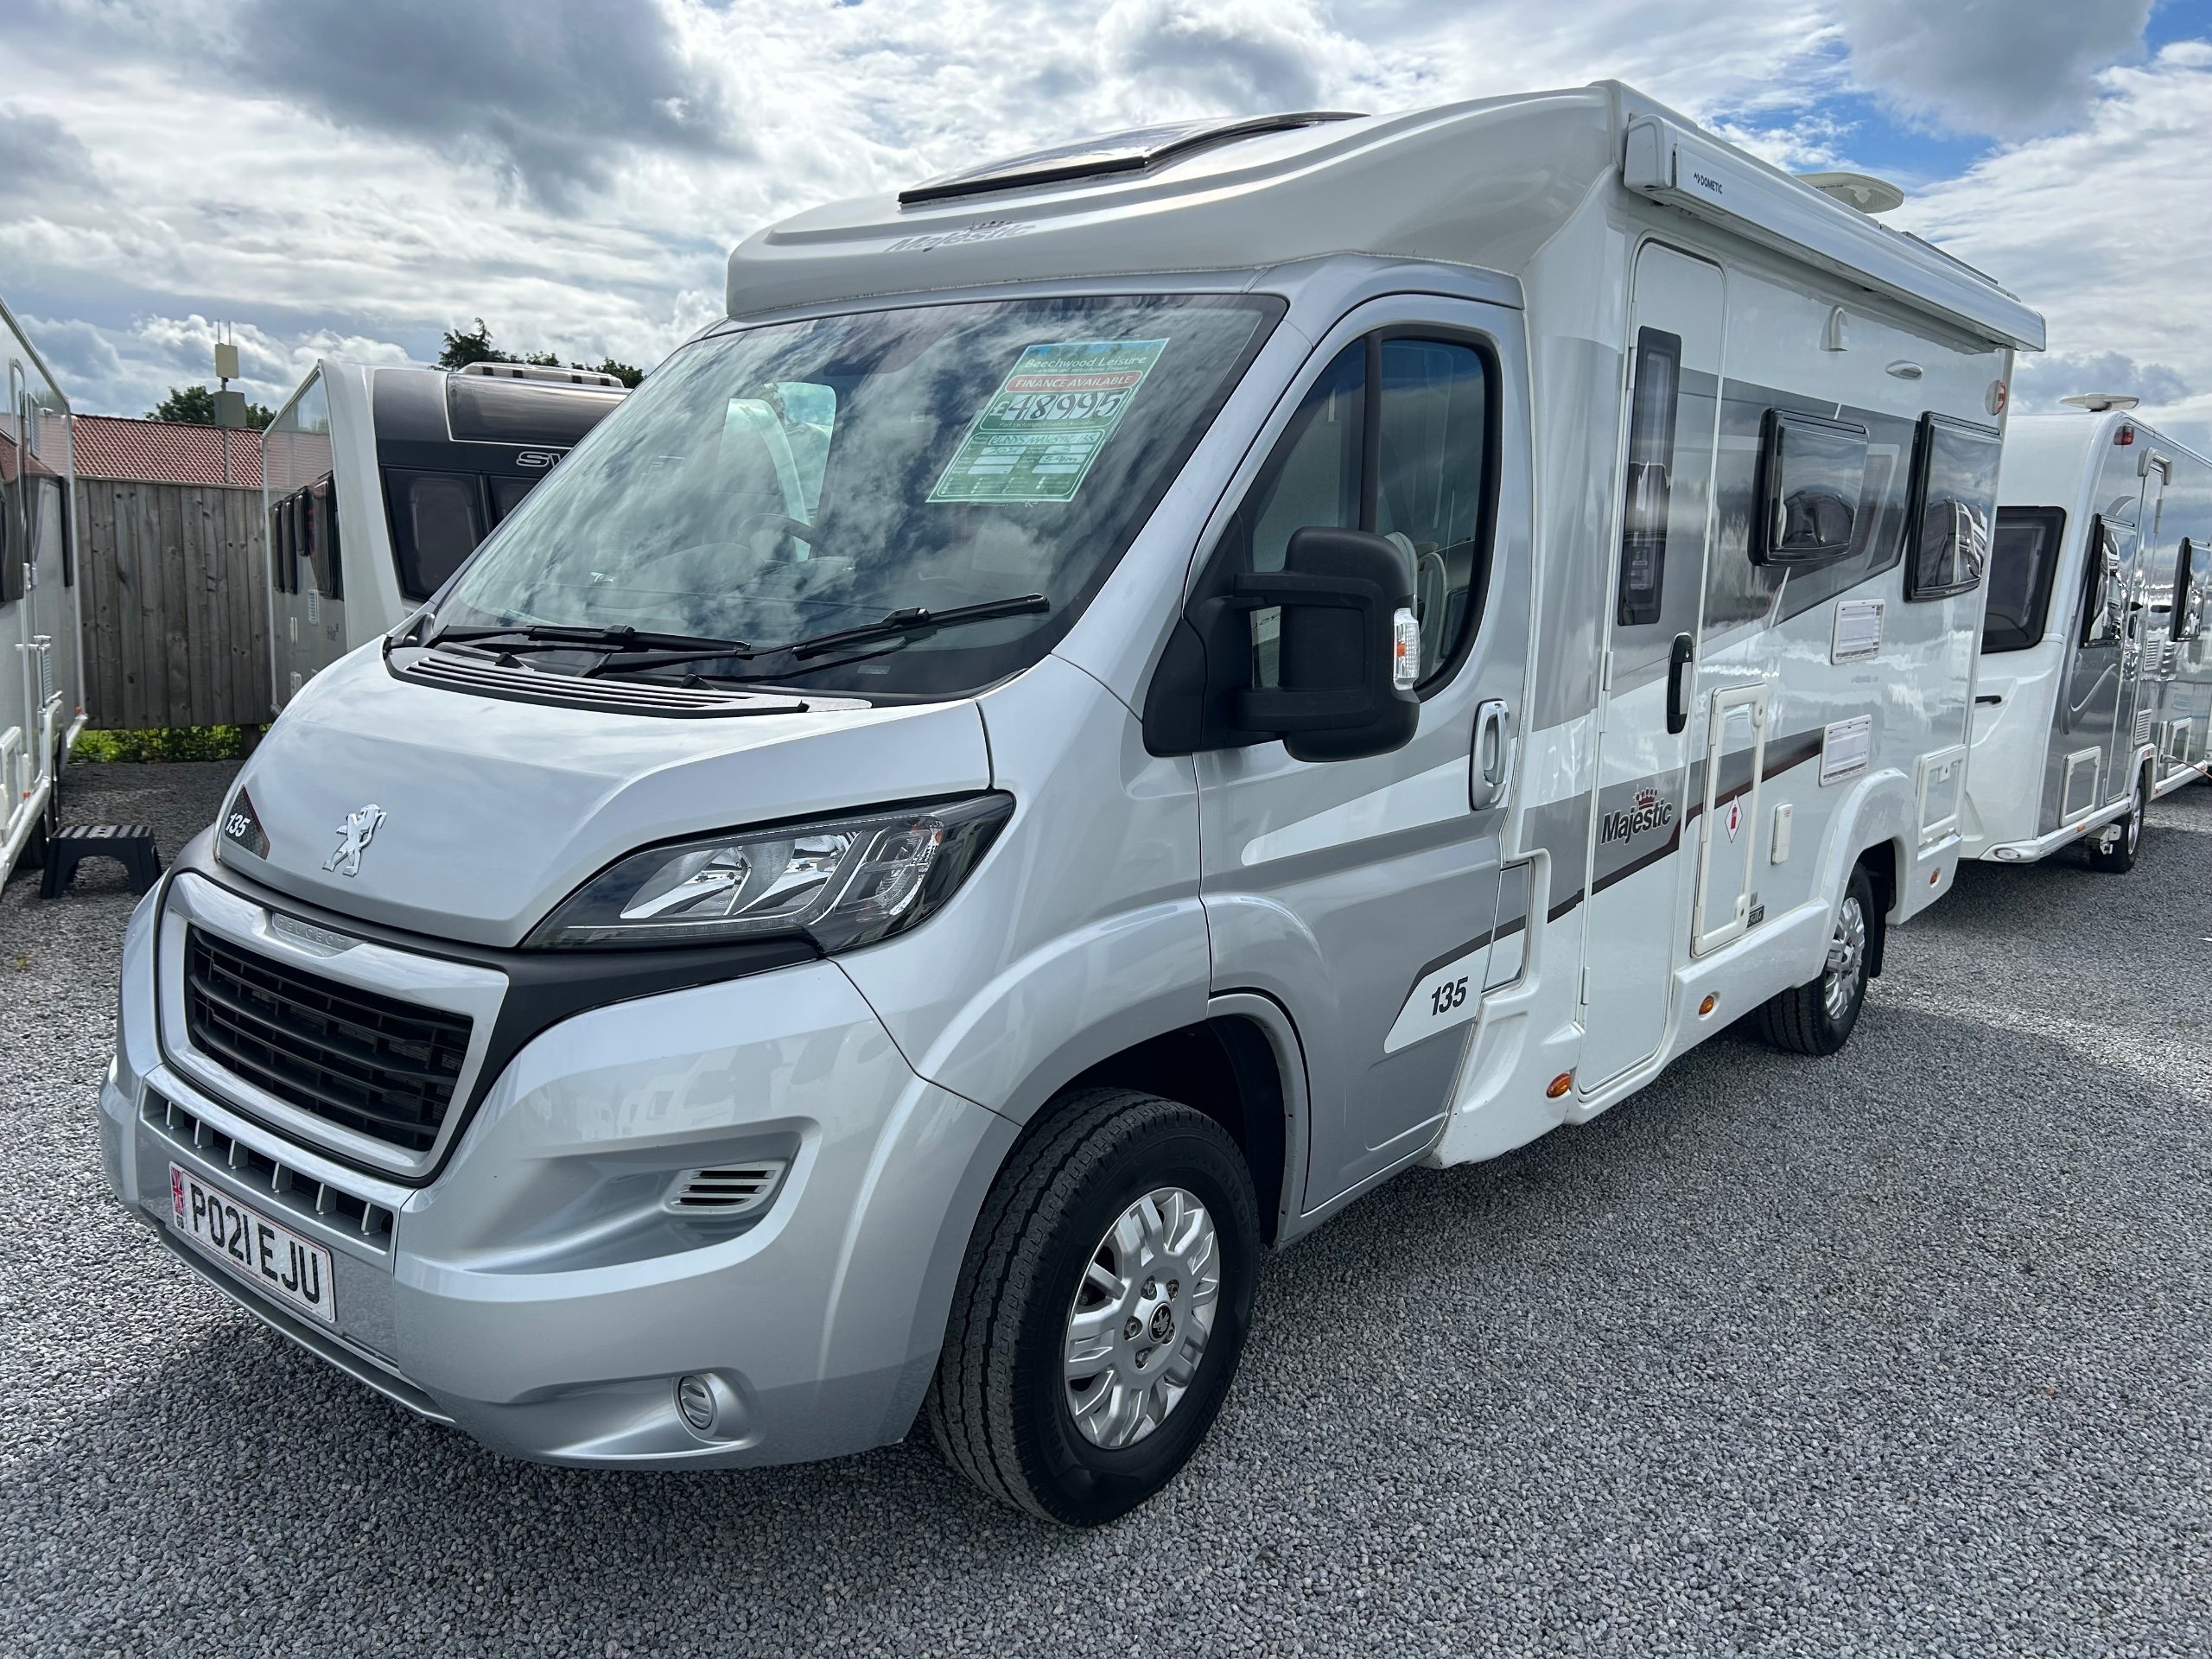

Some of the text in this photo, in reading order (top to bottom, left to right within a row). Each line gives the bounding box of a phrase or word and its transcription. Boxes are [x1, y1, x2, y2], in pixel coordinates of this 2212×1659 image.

[1700, 175, 1723, 194] DOMETIC
[1025, 356, 1147, 368] Beechwood Leisure
[1014, 375, 1134, 389] FINANCE AVAILABLE
[226, 812, 251, 837] 135
[1600, 798, 1672, 845] Majestic
[1431, 976, 1469, 1016] 135
[190, 1183, 321, 1305] PO21 EJU
